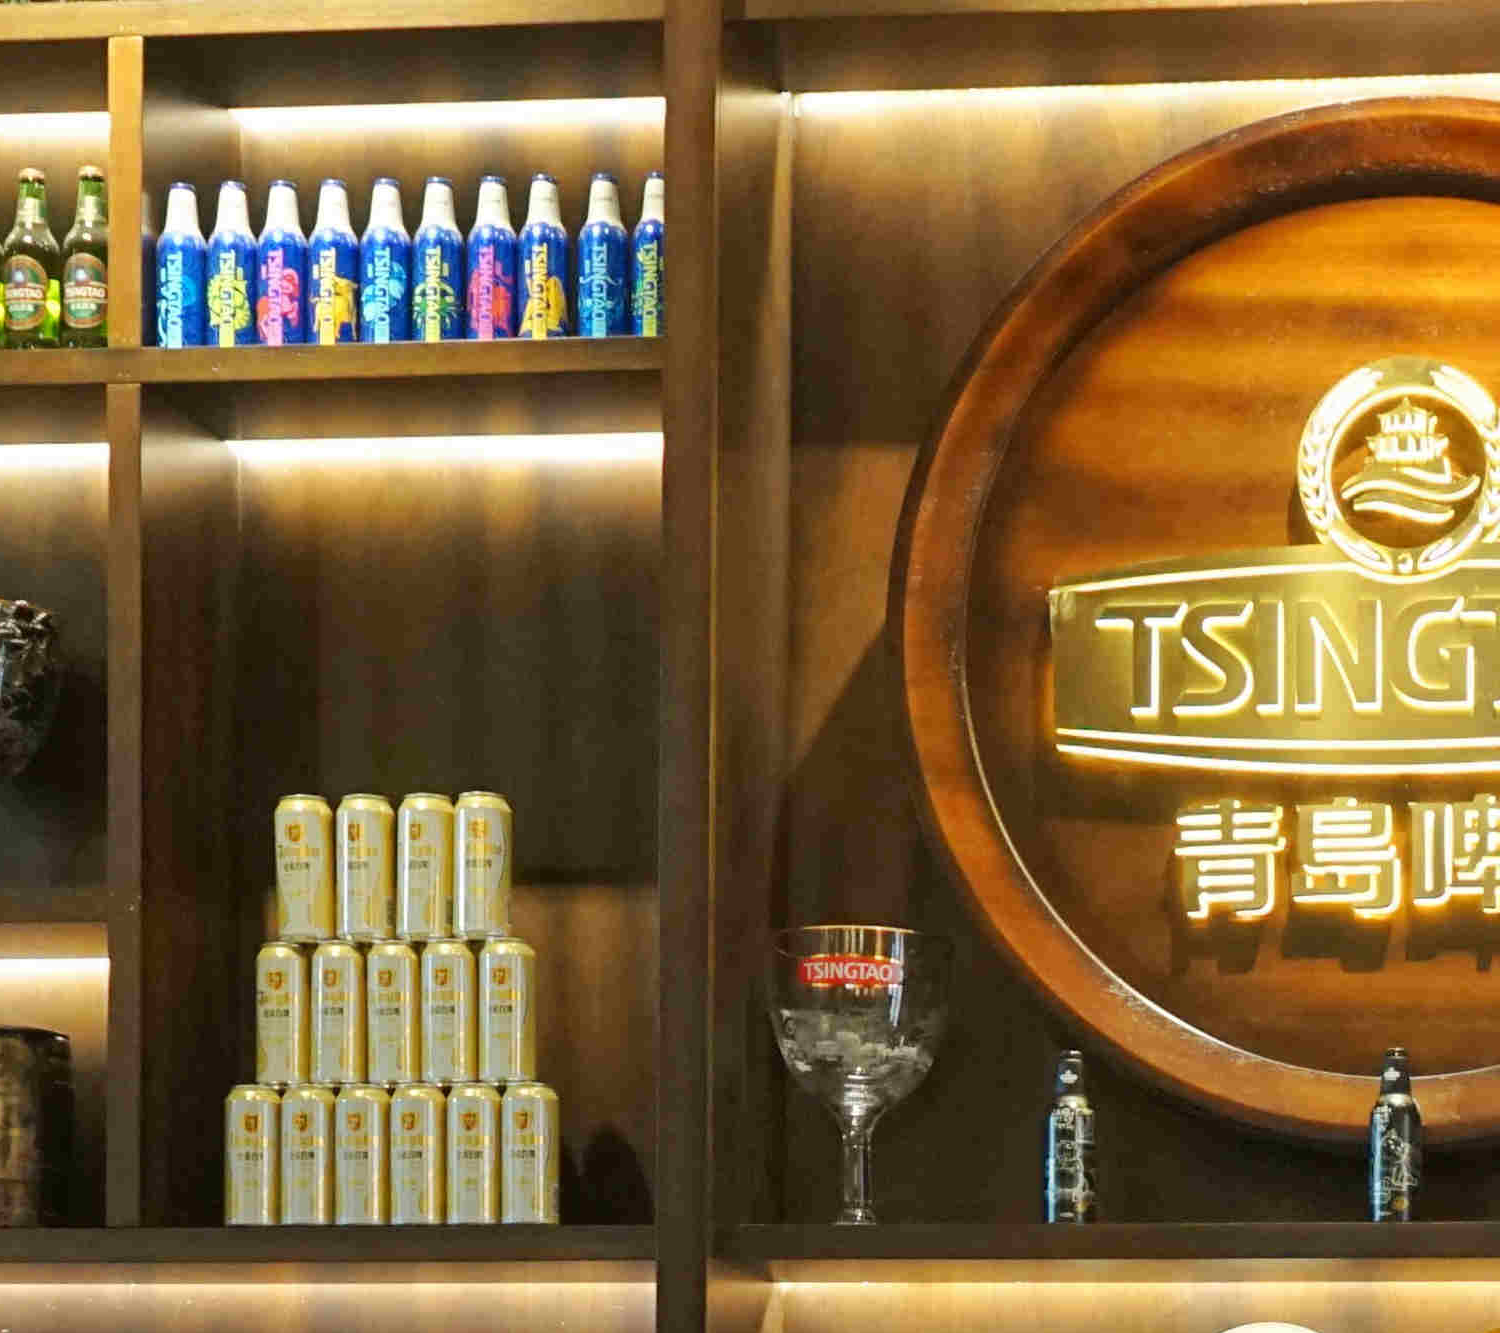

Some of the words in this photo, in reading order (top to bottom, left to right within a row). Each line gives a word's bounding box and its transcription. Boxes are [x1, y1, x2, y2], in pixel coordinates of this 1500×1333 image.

[375, 247, 390, 324] TSINGTAO
[532, 242, 547, 319] TSINGTAO
[592, 242, 607, 318] TSINGTAO
[803, 961, 892, 981] TSINGTAO
